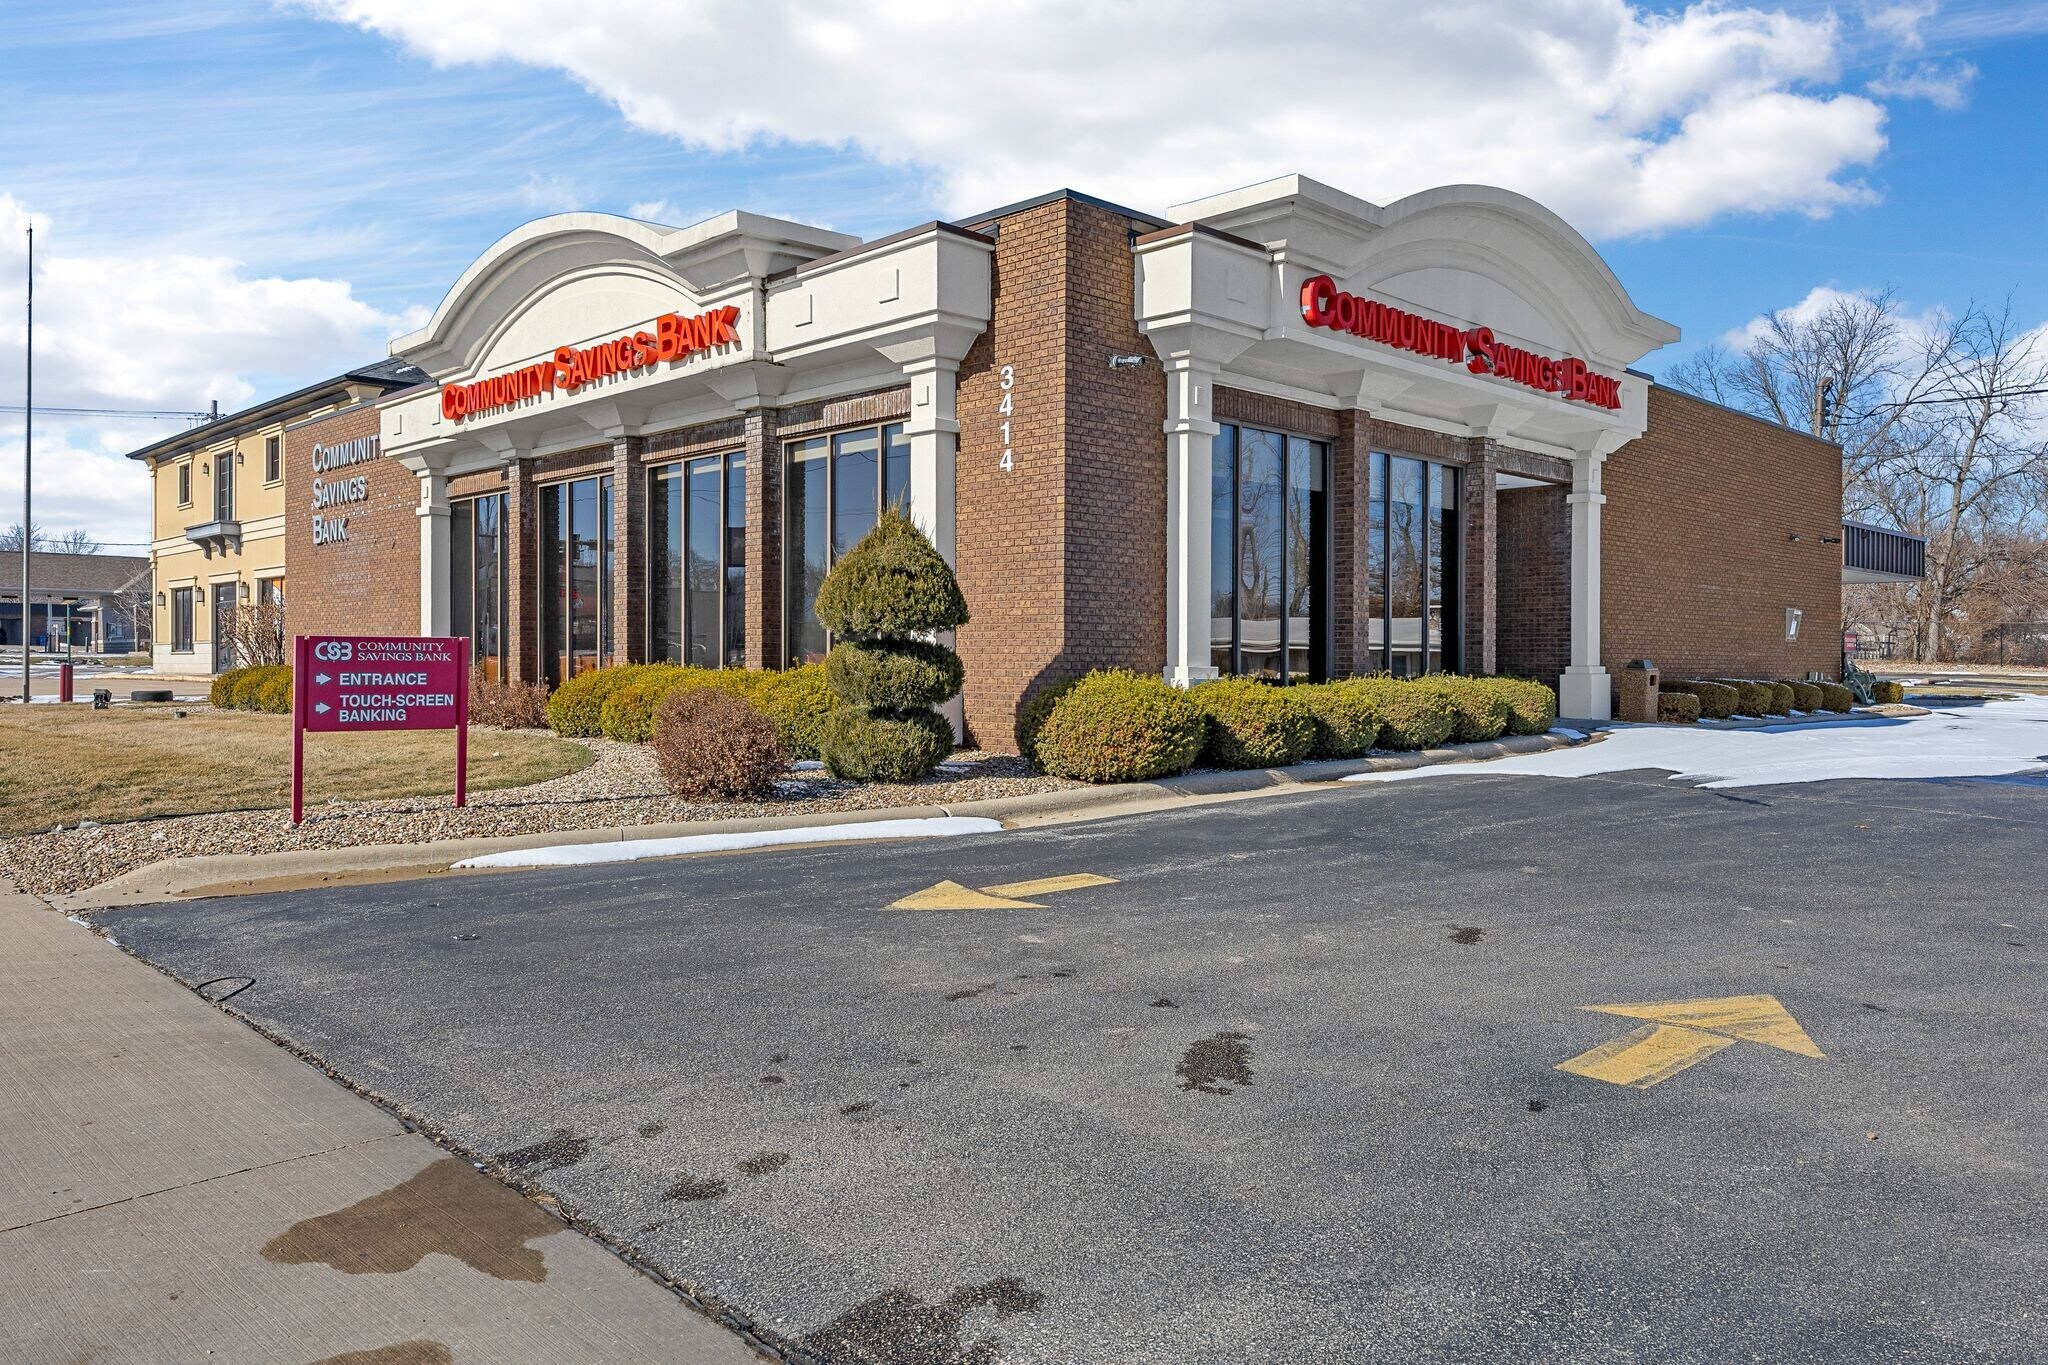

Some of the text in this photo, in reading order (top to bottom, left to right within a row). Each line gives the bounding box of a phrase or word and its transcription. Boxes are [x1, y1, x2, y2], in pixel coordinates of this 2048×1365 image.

[1300, 275, 1622, 409] COMMUNITY SAVINGS BANK
[441, 305, 741, 420] COMMUNITY SAVINGS BANK
[999, 365, 1014, 472] 3414
[312, 434, 379, 473] COMMUNIT
[313, 476, 368, 509] SAVINGS
[312, 514, 348, 545] BANK
[357, 642, 445, 651] COMMUNITY
[357, 652, 452, 662] SAVINGS BANK
[339, 673, 428, 686] ENTRANCE
[339, 709, 407, 722] BANKING
[340, 694, 454, 707] TOUCH-SCREEN
